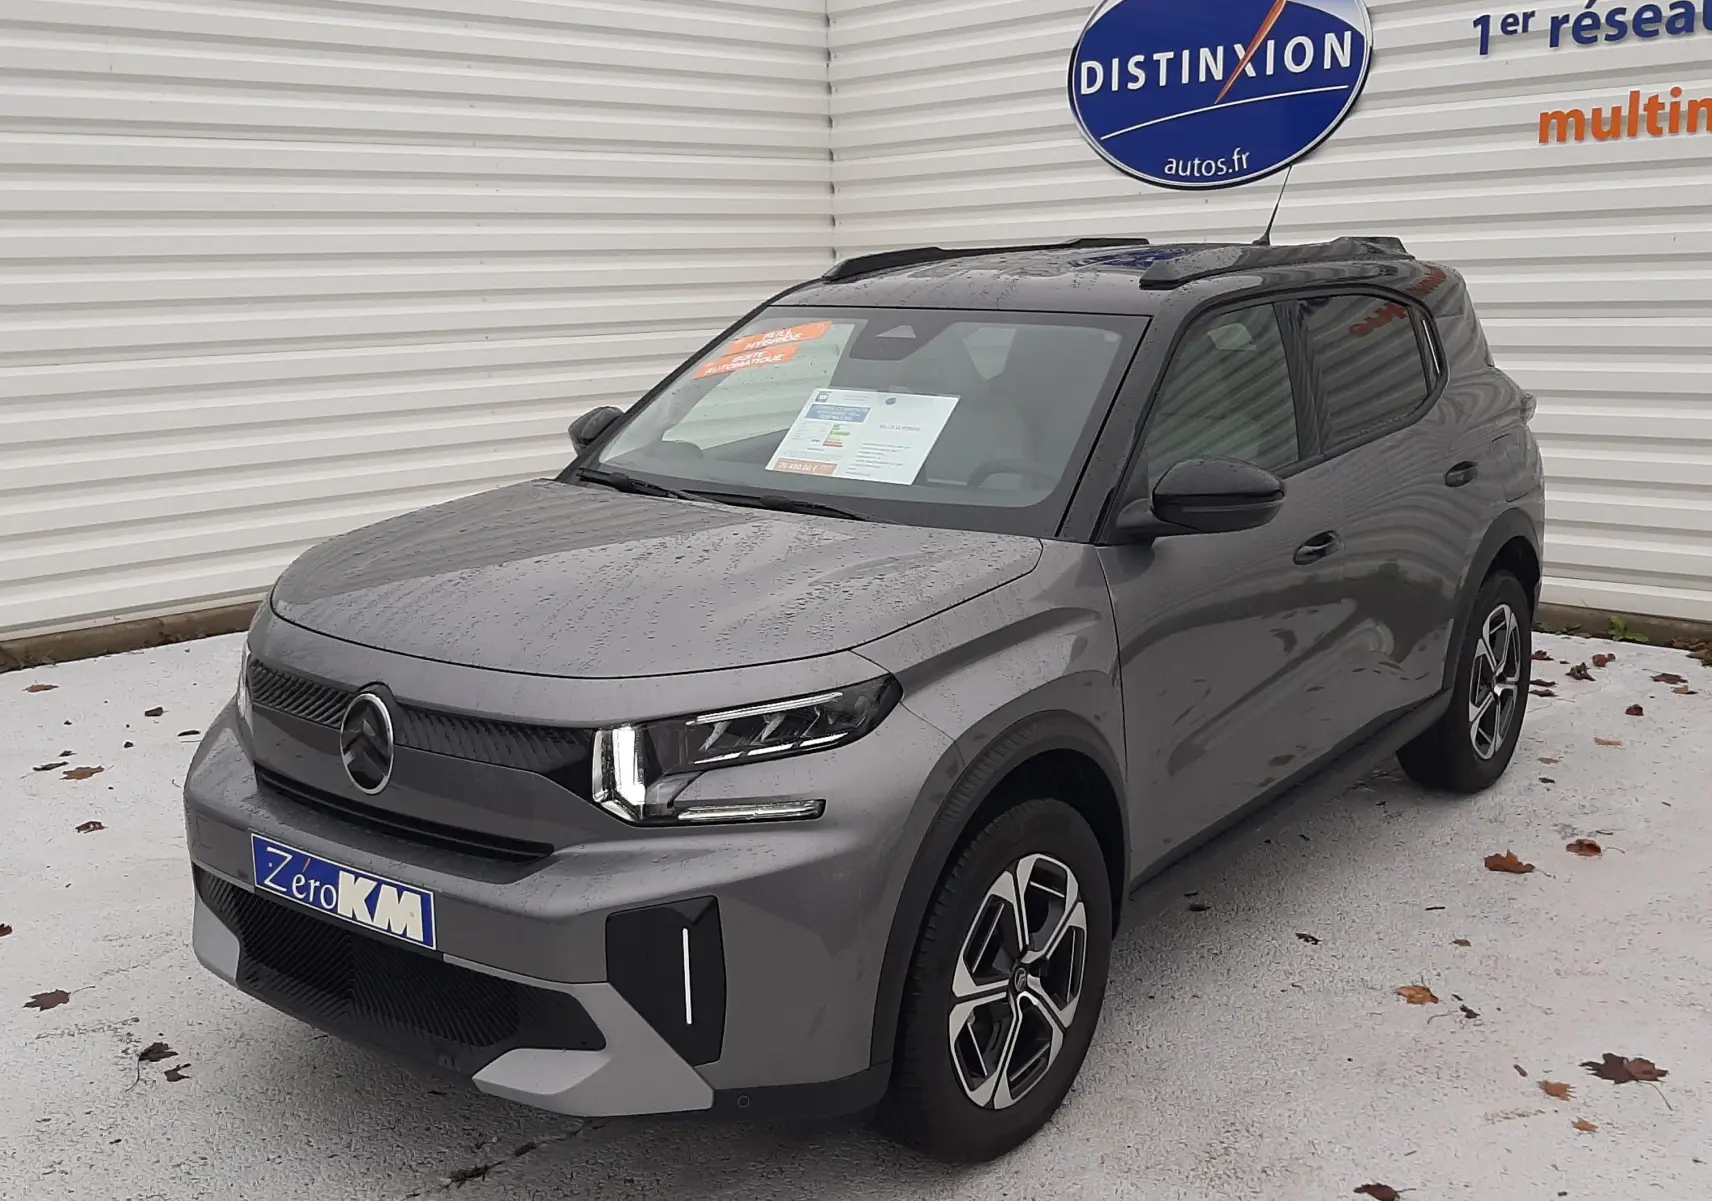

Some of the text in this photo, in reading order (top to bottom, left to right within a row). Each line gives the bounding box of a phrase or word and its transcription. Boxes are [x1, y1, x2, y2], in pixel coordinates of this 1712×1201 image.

[1473, 0, 1712, 56] 1er résea
[1080, 30, 1353, 95] DISTINXION
[1164, 147, 1251, 177] autos.fr
